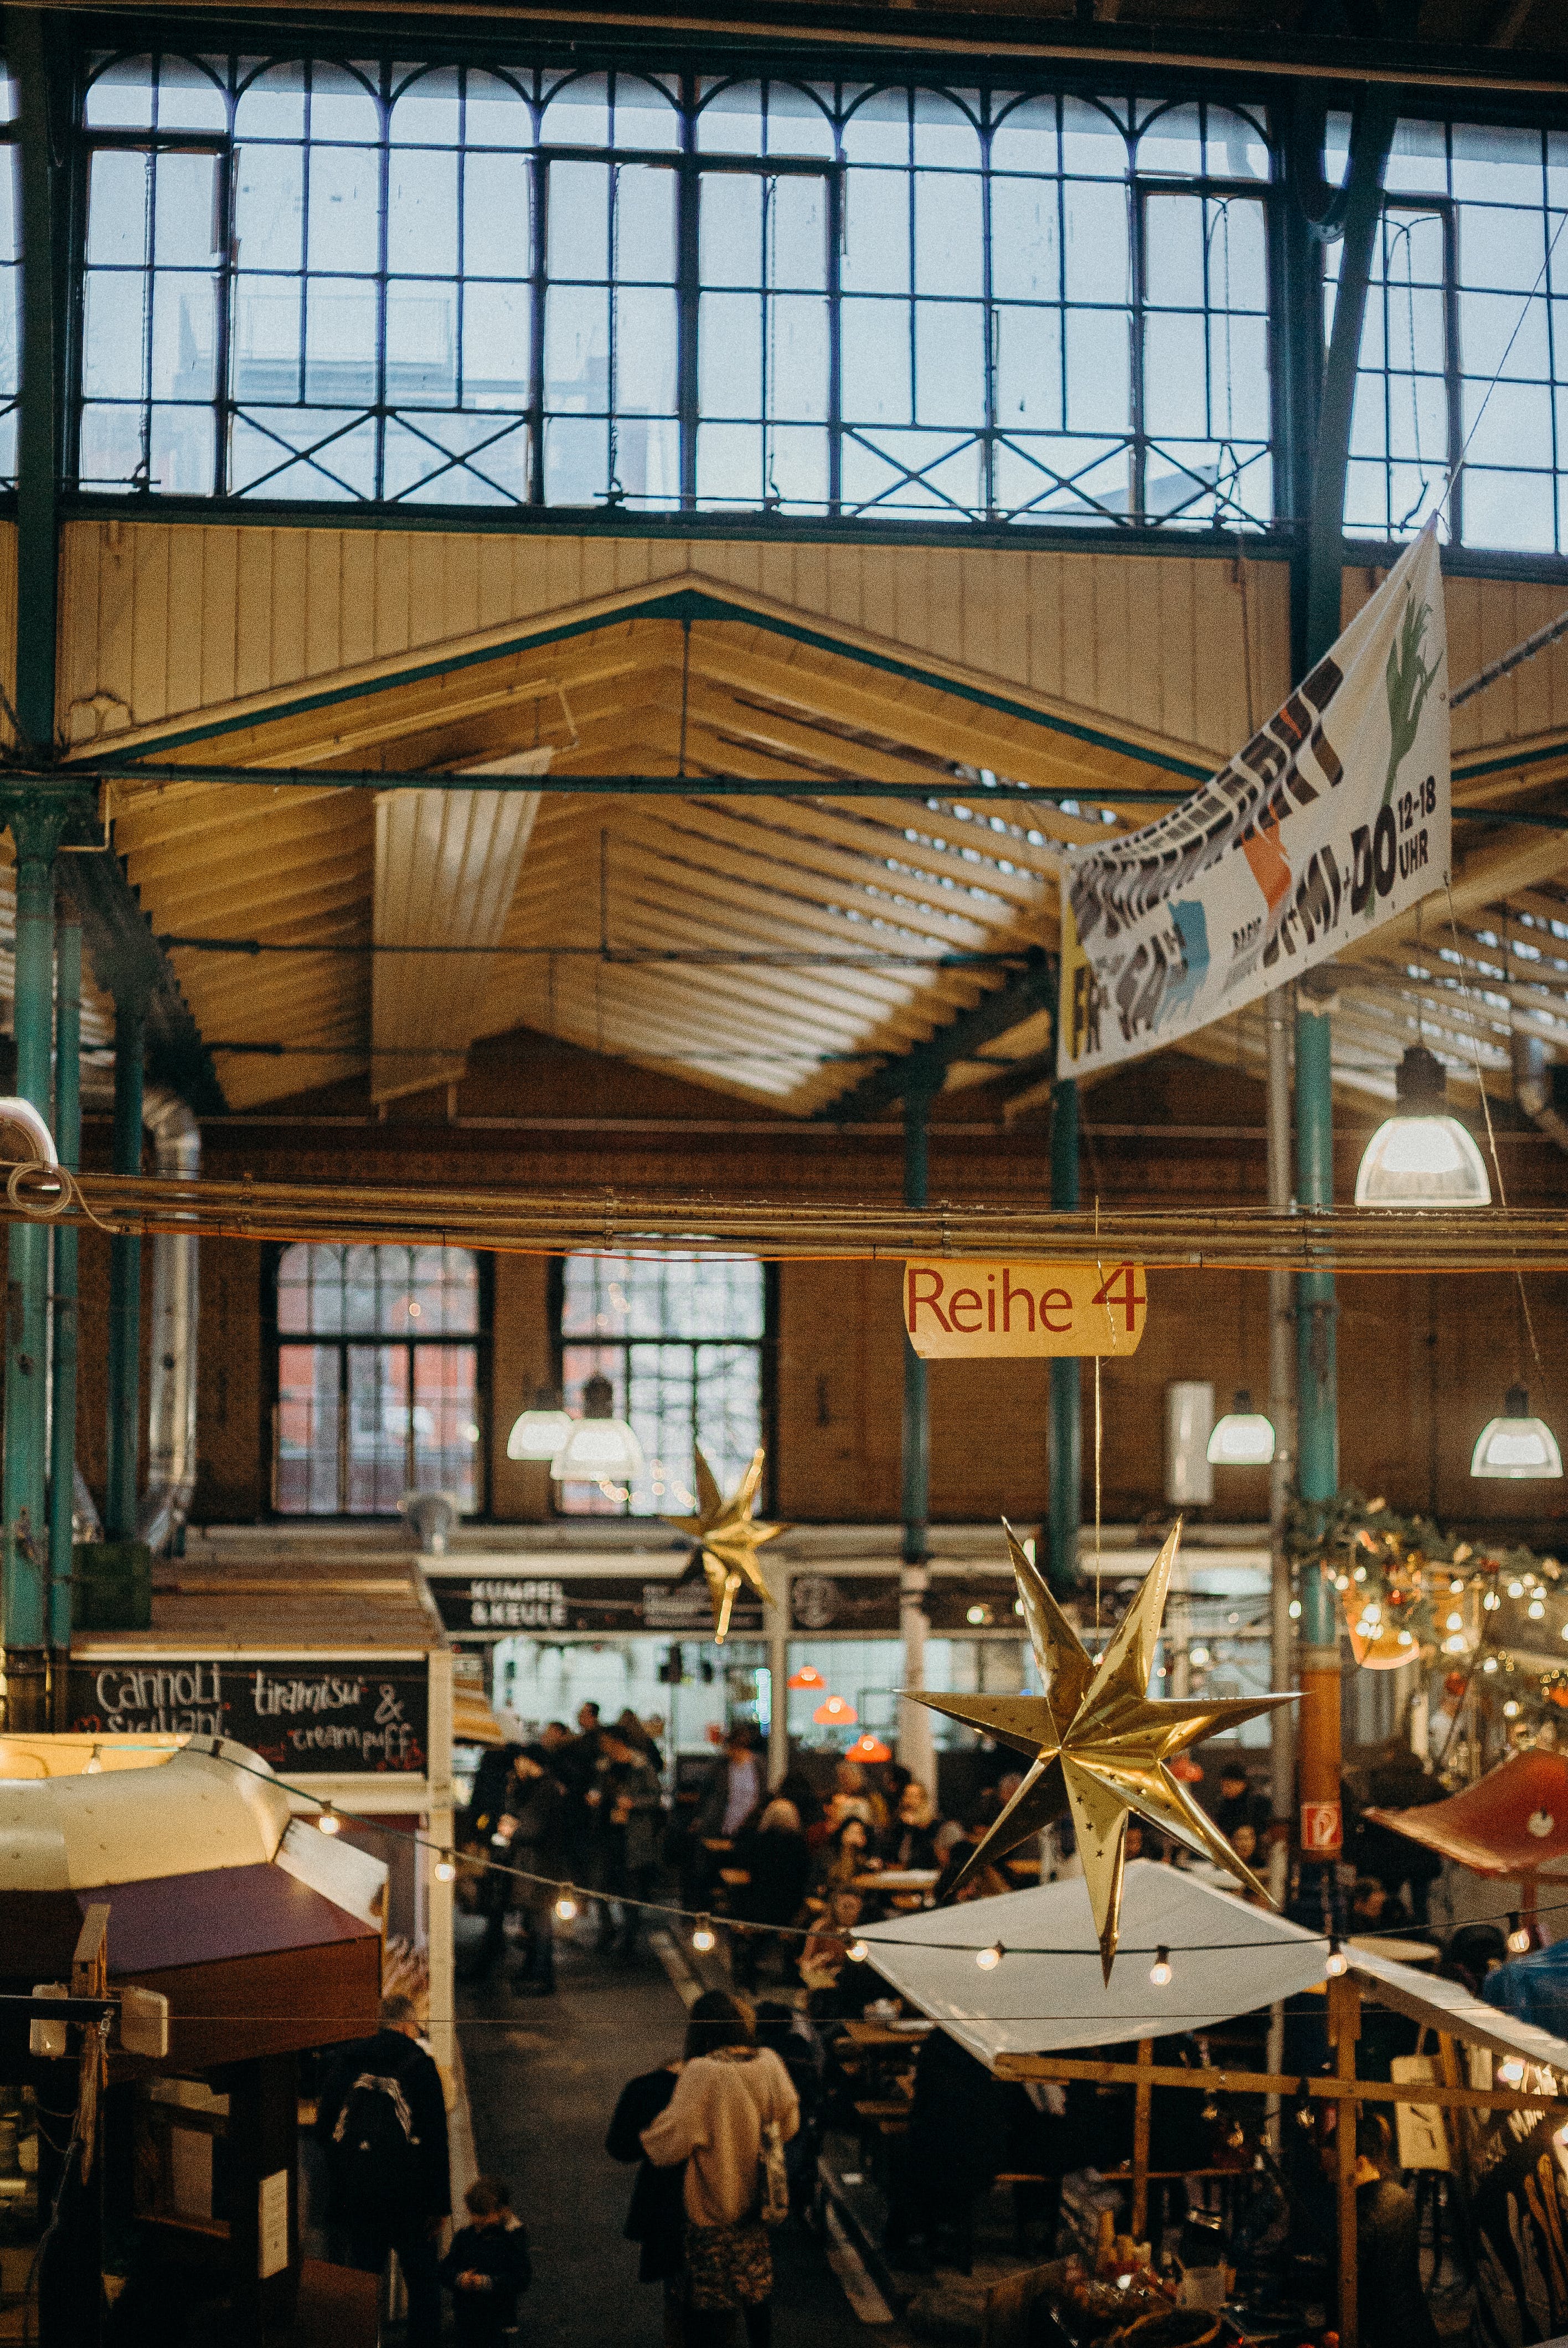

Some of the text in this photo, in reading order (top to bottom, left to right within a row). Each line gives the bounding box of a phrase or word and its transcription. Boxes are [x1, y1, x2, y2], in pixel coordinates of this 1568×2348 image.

[1398, 775, 1436, 832] 12-18
[1399, 828, 1428, 879] UHR
[908, 1261, 1146, 1332] Reihe 4
[471, 1581, 564, 1602] KUMPEL
[373, 1684, 404, 1723] &
